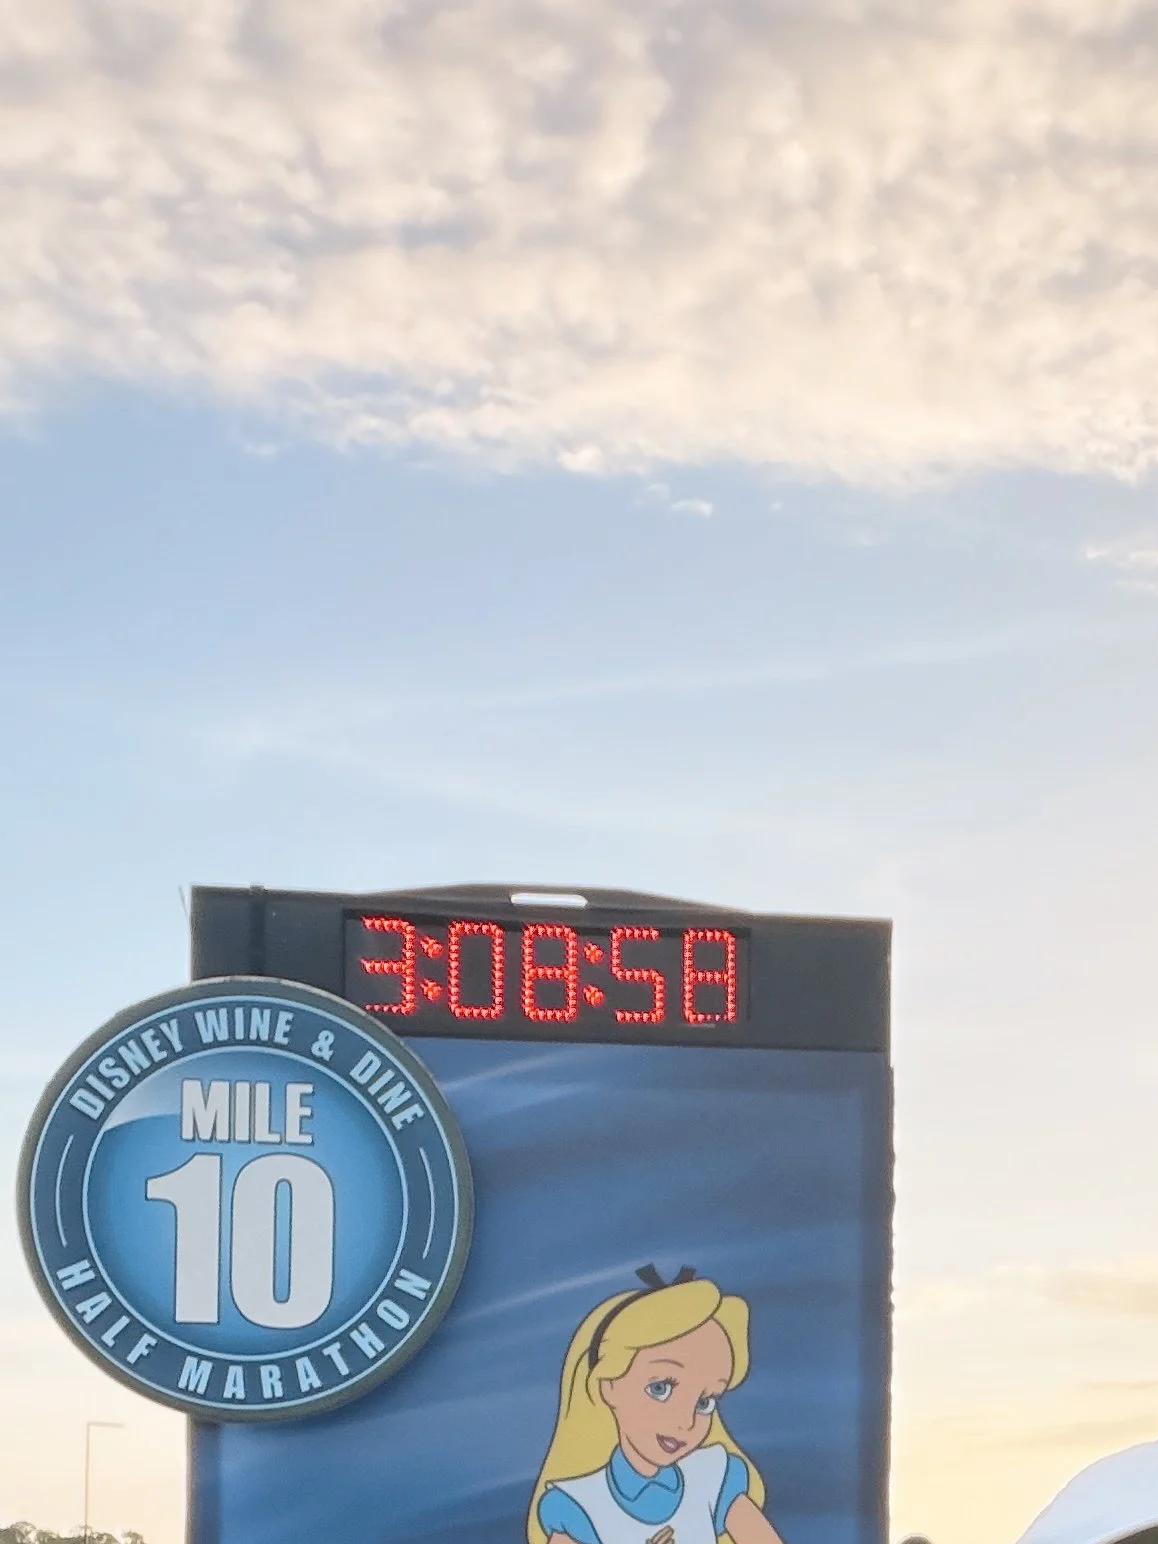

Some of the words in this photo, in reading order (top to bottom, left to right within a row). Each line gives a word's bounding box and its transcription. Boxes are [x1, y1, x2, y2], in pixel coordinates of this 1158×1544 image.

[361, 915, 737, 1023] 3:08:58
[69, 1018, 185, 1121] DISNEY
[194, 1007, 295, 1046] WINE
[311, 1029, 336, 1063] &
[349, 1050, 428, 1131] DINE
[180, 1078, 315, 1145] MILE
[144, 1152, 336, 1330] 10
[56, 1259, 157, 1365] HALF
[177, 1268, 432, 1400] MARATHON
